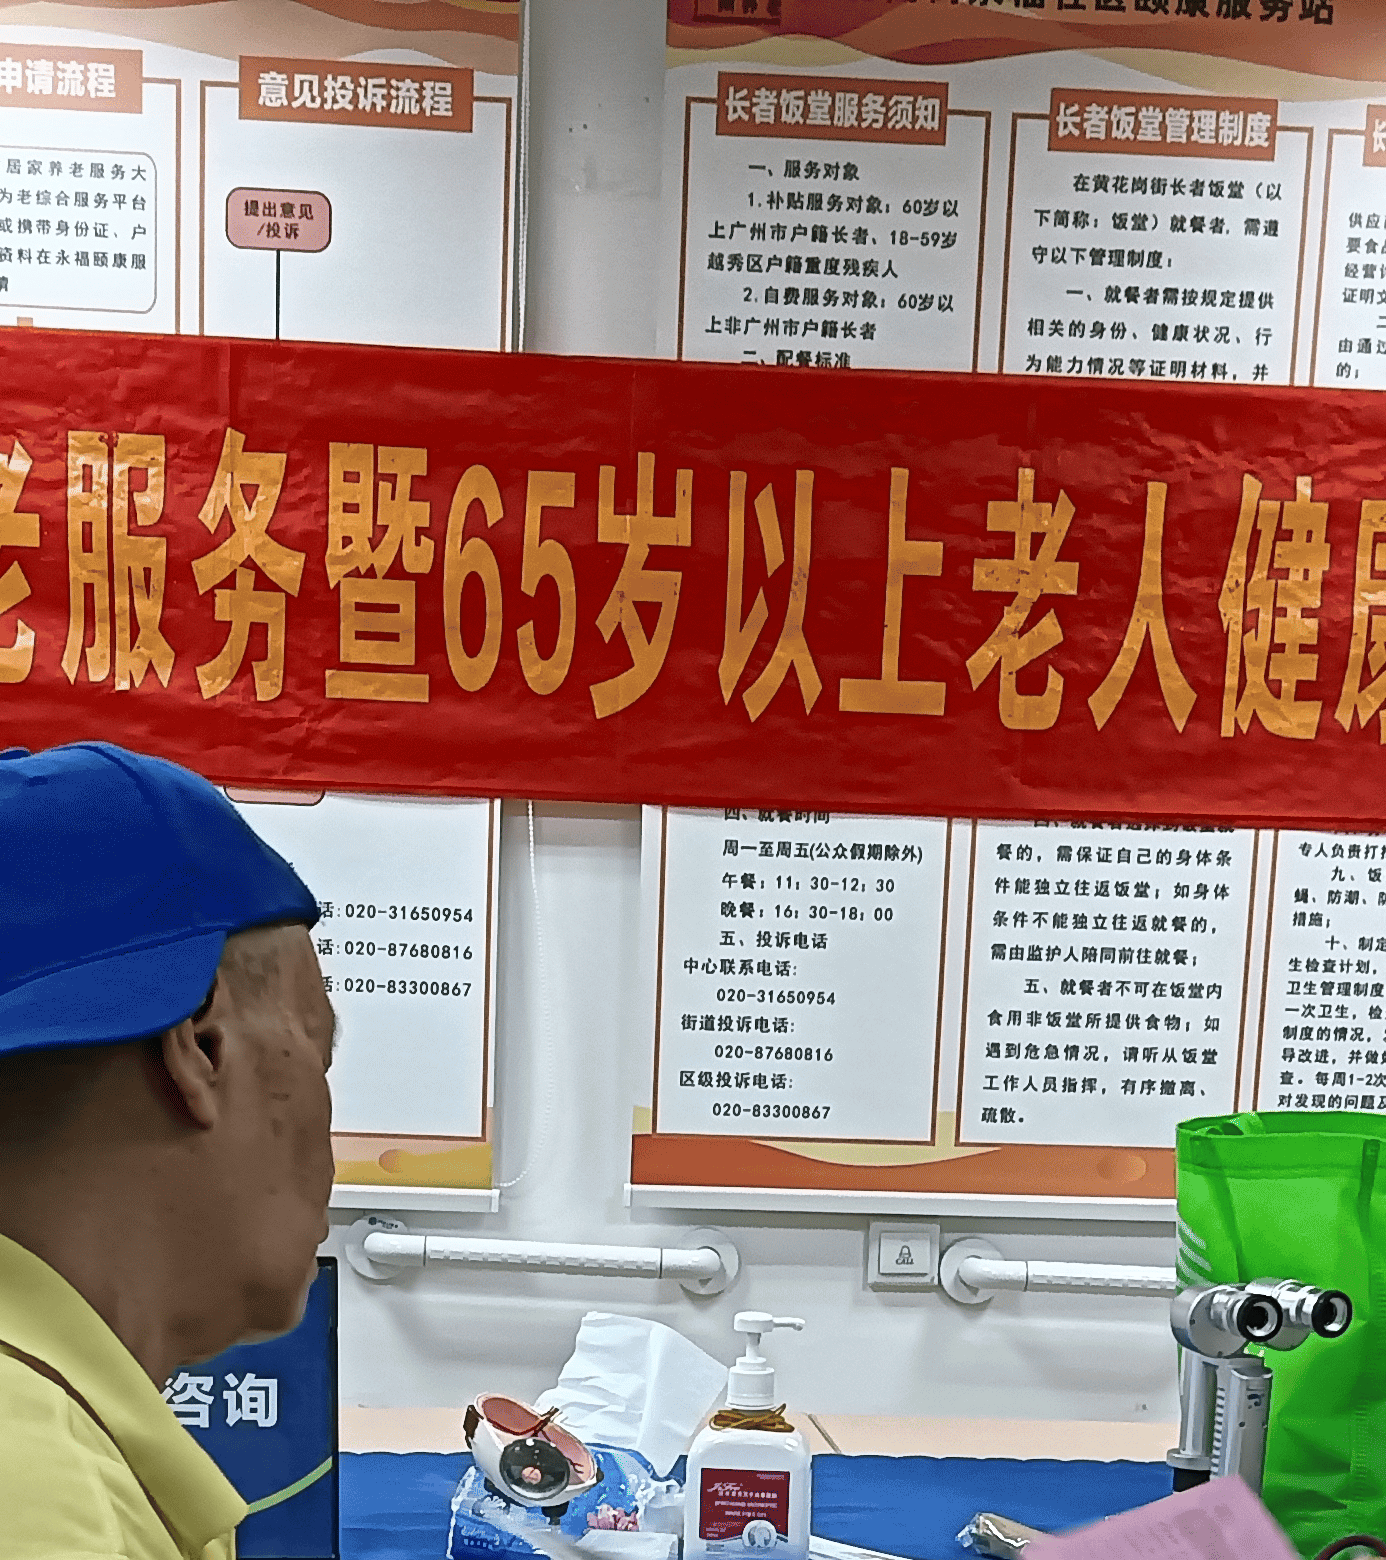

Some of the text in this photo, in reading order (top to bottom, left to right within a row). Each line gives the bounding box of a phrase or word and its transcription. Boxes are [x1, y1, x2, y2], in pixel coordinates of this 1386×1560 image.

[258, 73, 453, 117] 意见投诉流程
[724, 86, 941, 132] 长者饭堂服务须知
[1056, 104, 1271, 147] 长者饭堂管理制度
[748, 160, 859, 182] 一、服务对象
[244, 200, 314, 220] 提出意见
[258, 222, 300, 240] /投诉
[707, 253, 898, 279] 越秀区户籍重度残疾人
[1066, 284, 1274, 310] 一、就餐者需按规定提供
[705, 315, 876, 341] 上非广州市户籍长者
[1027, 318, 1273, 347] 相关的身份、健康状况、行
[722, 838, 924, 864] 周一至周五(公众假期除外)
[996, 843, 1233, 869] 餐的，需保证自己的身体条
[719, 930, 828, 951] 五、投诉电话
[716, 987, 836, 1007] 020-31650954
[1023, 977, 1223, 1001] 五、就餐者不可在饭堂内
[714, 1044, 834, 1062] 020-87680816
[985, 1042, 1218, 1065] 遇到危急情况，请听从饭堂
[712, 1102, 831, 1120] 020-83300867
[160, 1372, 279, 1429] 咨询
